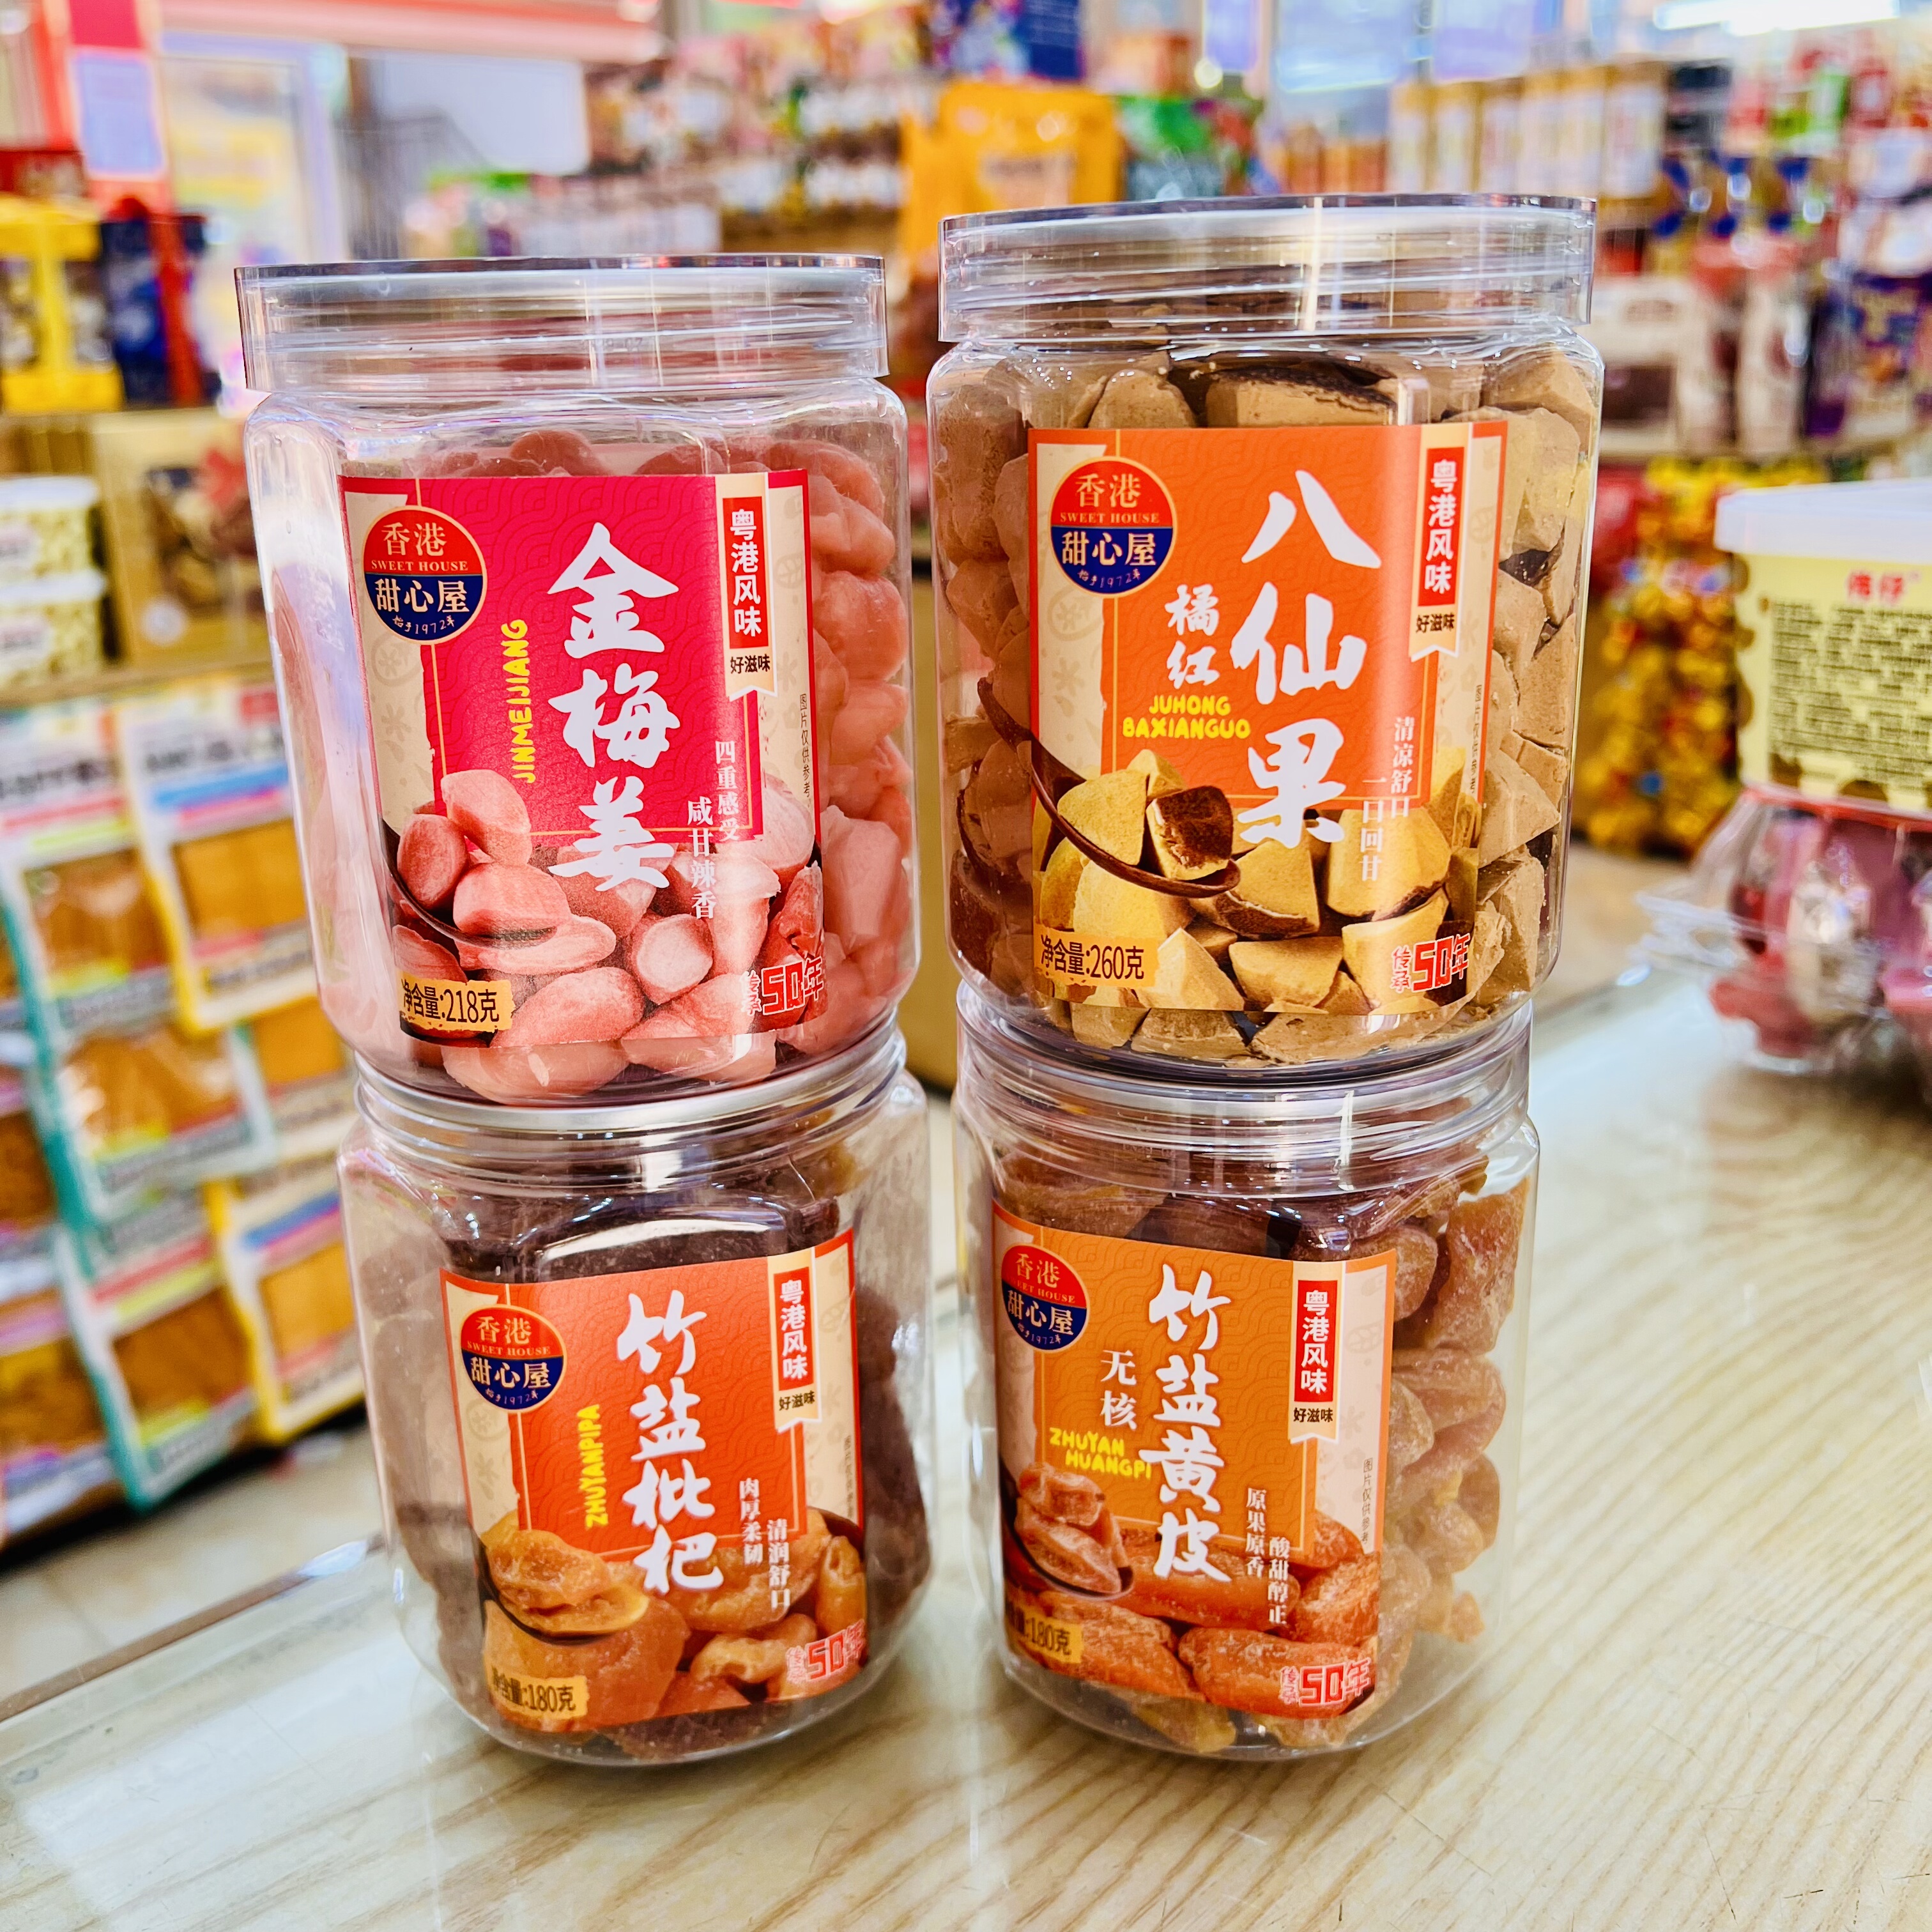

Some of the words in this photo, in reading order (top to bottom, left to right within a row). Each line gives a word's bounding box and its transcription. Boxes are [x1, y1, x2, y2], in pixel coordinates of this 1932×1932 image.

[1075, 473, 1141, 509] 香港
[1060, 512, 1105, 524] SWEET
[1110, 512, 1160, 525] HOUSE
[1424, 459, 1457, 595] 粤港风味
[381, 522, 447, 557] 香港
[1061, 532, 1156, 566] 甜心屋
[371, 560, 414, 572] SWEET
[418, 560, 468, 572] HOUSE
[730, 509, 762, 638] 粤港风味
[375, 578, 470, 613] 甜心屋
[392, 615, 456, 635] 始于1972年
[1164, 583, 1220, 689] 橘红
[1415, 612, 1455, 634] 好滋味
[730, 654, 770, 674] 好滋味
[1230, 470, 1381, 848] 八仙果
[500, 619, 536, 784] JINMEIJIANG
[548, 522, 681, 891] 金梅姜
[1149, 694, 1231, 716] JUHONG
[799, 693, 811, 798] 图片仅供参考
[1123, 717, 1251, 740] BAXIANGUO
[1390, 716, 1414, 818] 清凉舒口
[715, 740, 740, 842] 四重感受
[1359, 776, 1386, 882] 一口回甘
[687, 796, 717, 919] 咸甘辣香
[1015, 1253, 1061, 1288] 香港
[1007, 1289, 1074, 1336] 甜心屋
[1038, 1288, 1076, 1304] HOUSE
[475, 1315, 532, 1345] 香港
[779, 1280, 808, 1380] 粤港风味
[1300, 1290, 1330, 1394] 粤港风味
[466, 1340, 503, 1356] SWEET
[507, 1346, 551, 1357] HOUSE
[470, 1356, 552, 1390] 甜心屋
[1100, 1349, 1137, 1430] 无核
[778, 1390, 815, 1411] 好滋味
[1293, 1407, 1333, 1422] 好滋味
[1138, 1264, 1232, 1583] 竹盐黄皮
[617, 1290, 723, 1595] 竹盐枇杷
[1049, 1427, 1124, 1457] ZHUYAN
[576, 1404, 608, 1529] ZHUYANPIPA
[1065, 1449, 1152, 1479] HUANGPI
[1246, 1487, 1267, 1579] 原果原香
